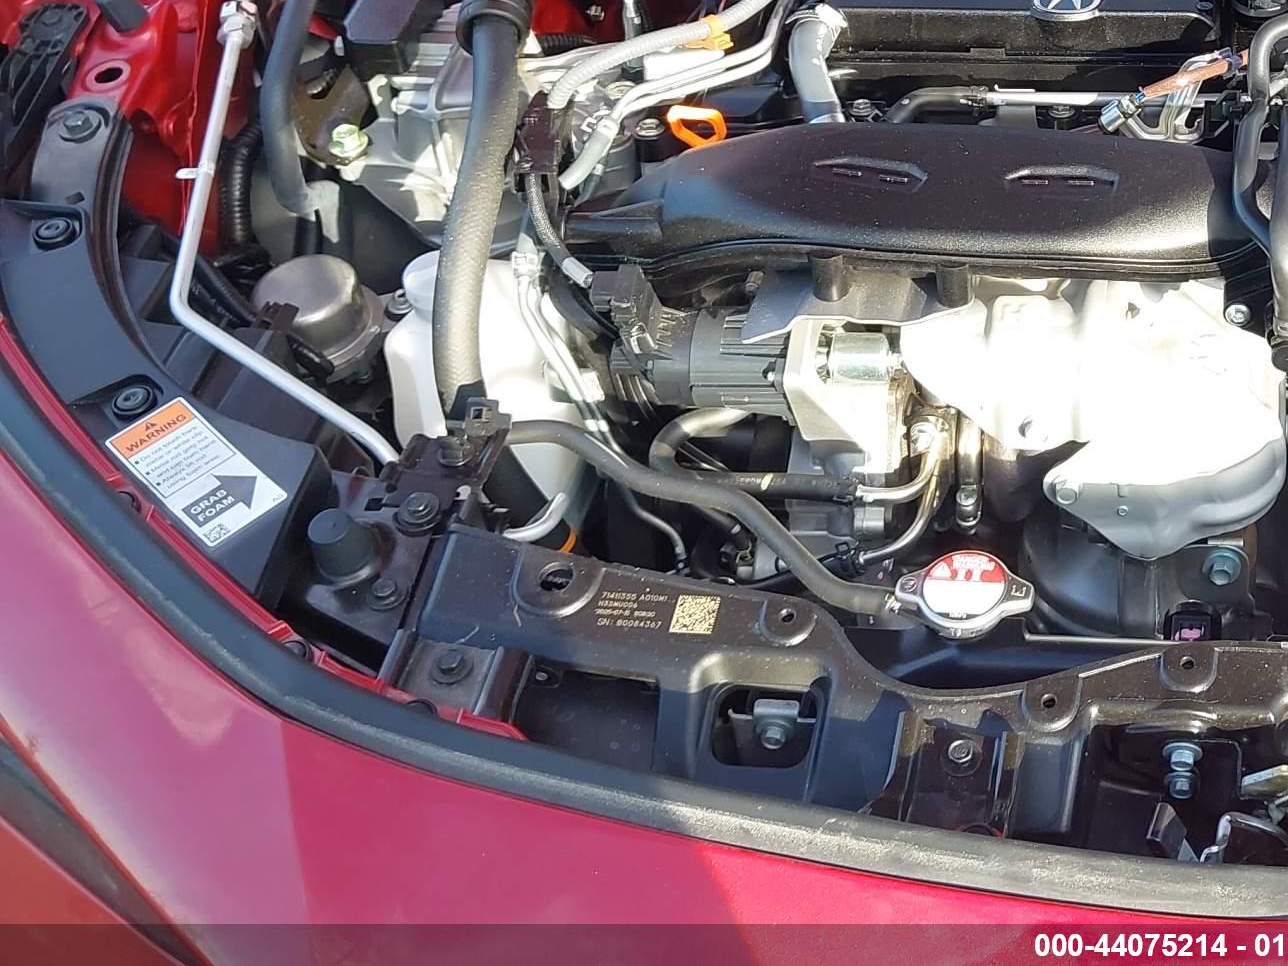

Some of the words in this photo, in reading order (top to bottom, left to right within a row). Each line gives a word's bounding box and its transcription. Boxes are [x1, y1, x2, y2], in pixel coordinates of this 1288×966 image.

[125, 414, 186, 452] WARNING
[139, 453, 151, 462] Do
[150, 446, 162, 455] not
[190, 489, 227, 514] GRAB
[199, 496, 235, 522] FOAM
